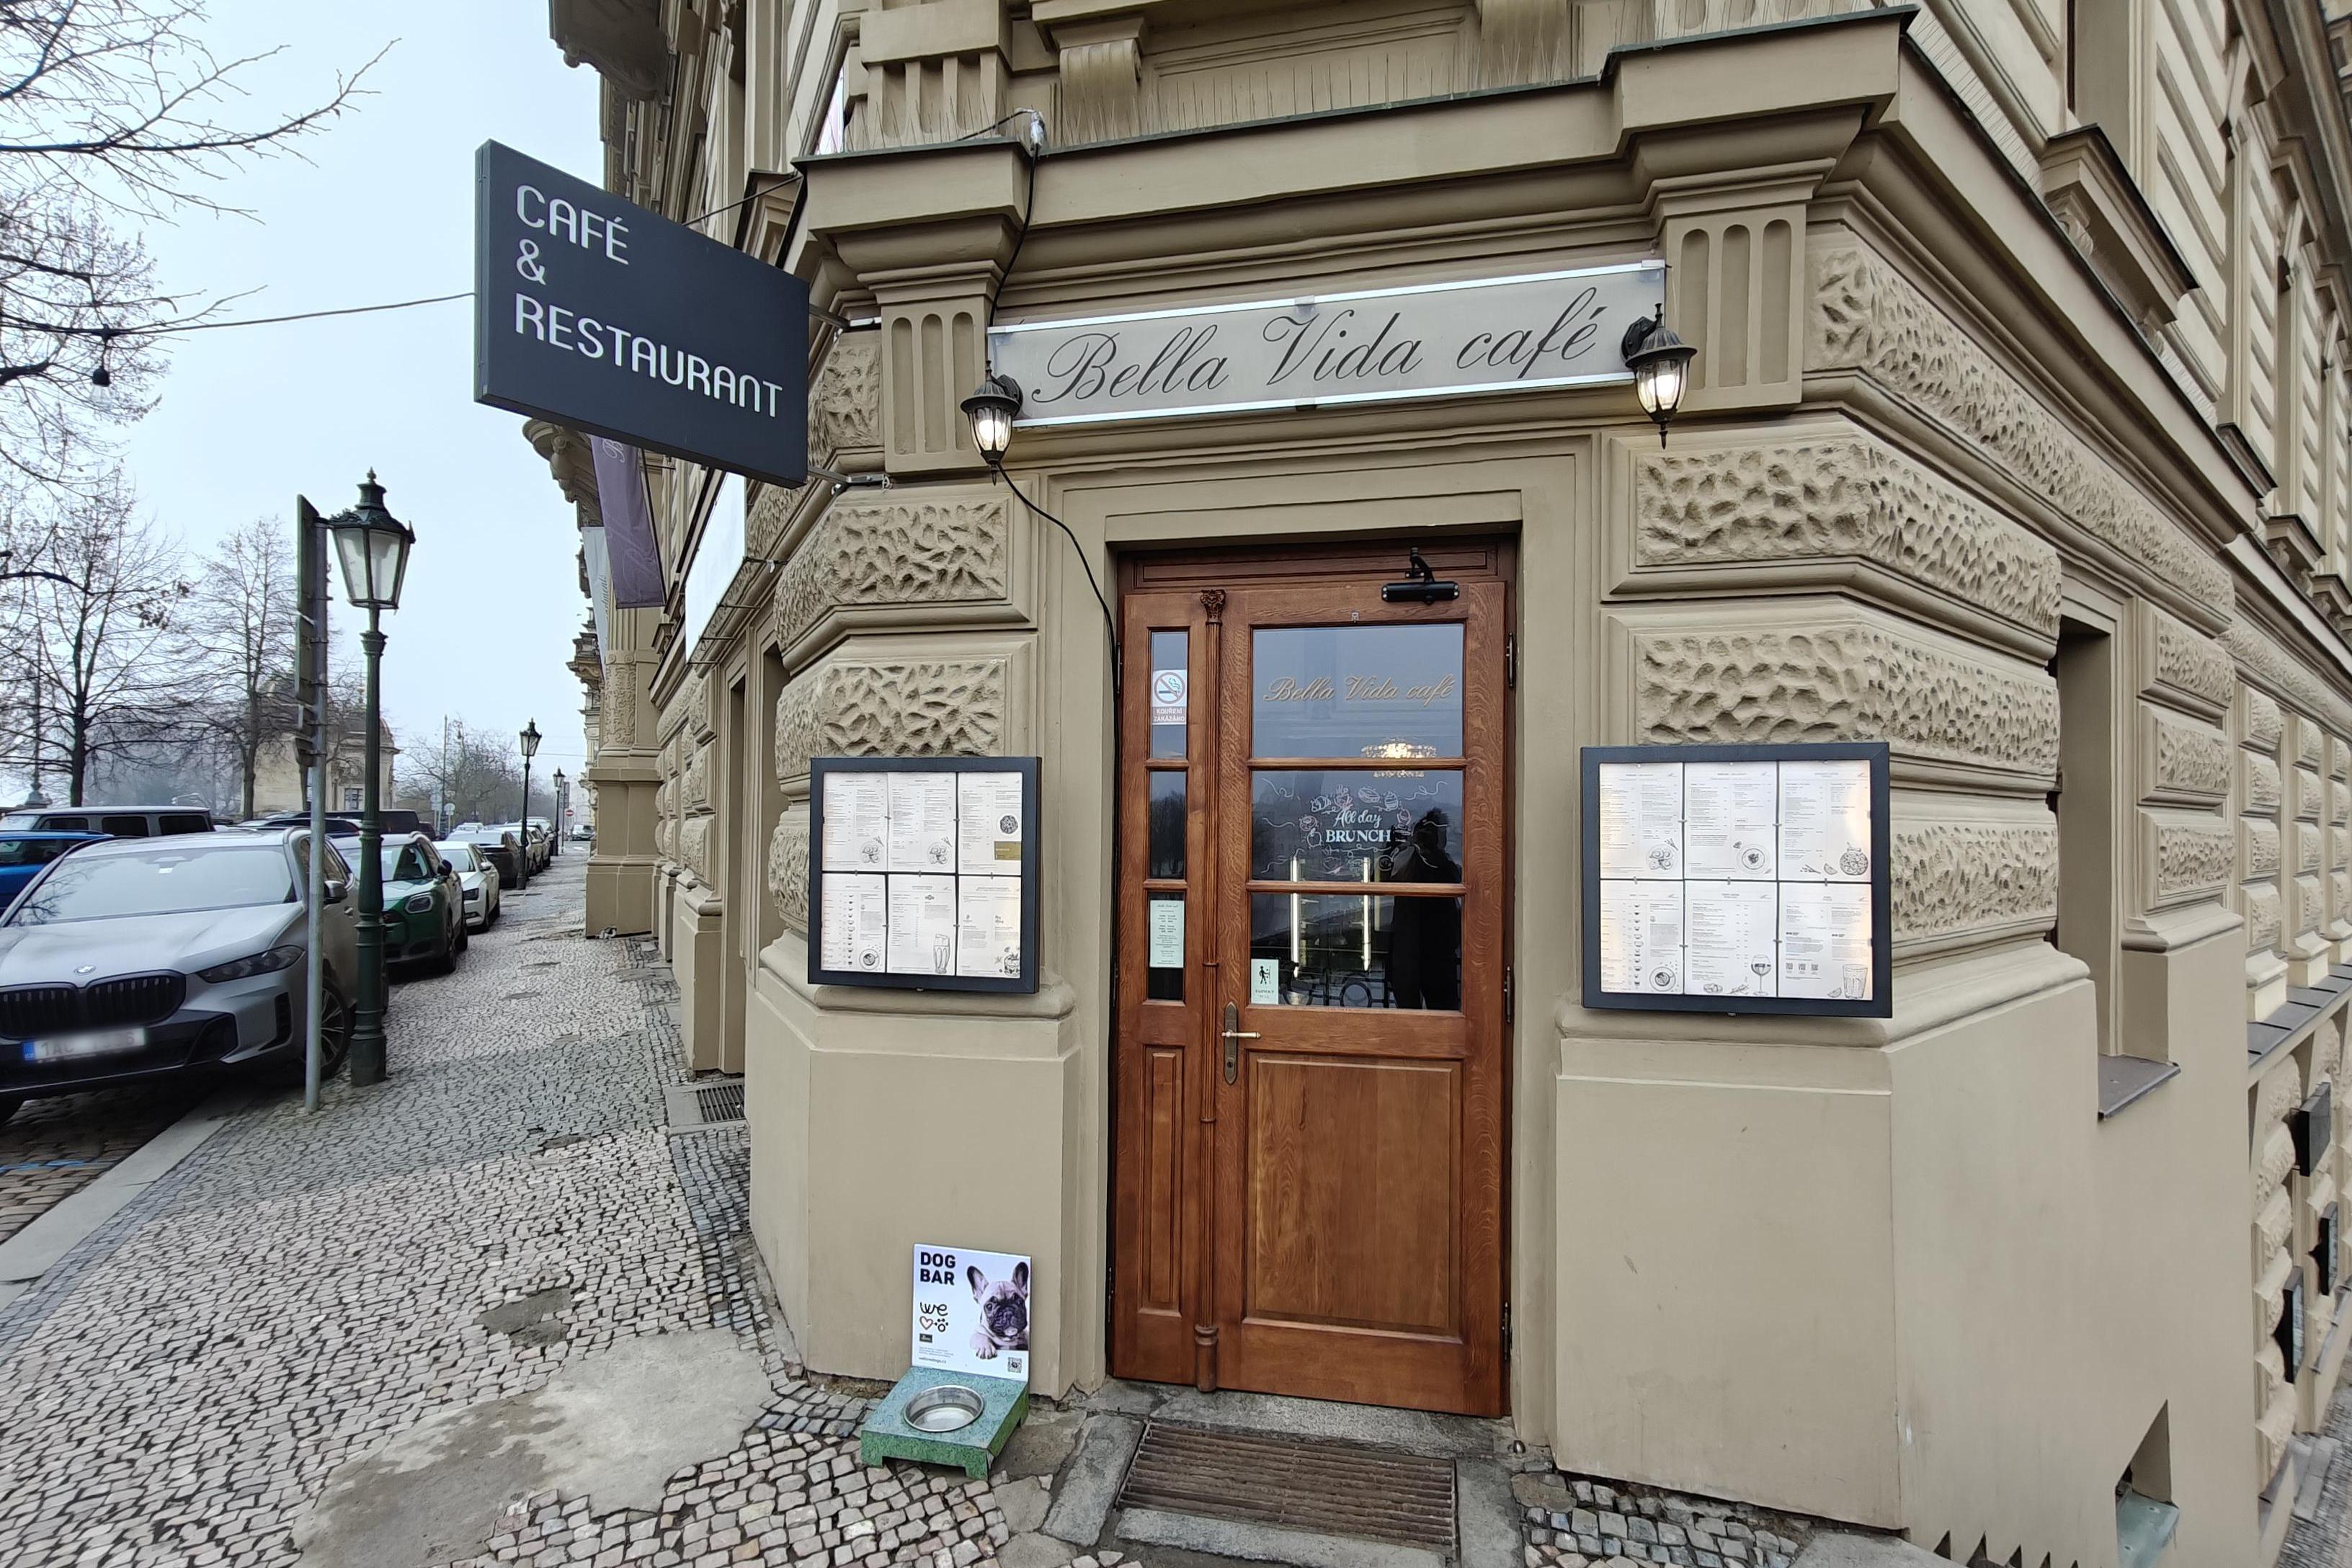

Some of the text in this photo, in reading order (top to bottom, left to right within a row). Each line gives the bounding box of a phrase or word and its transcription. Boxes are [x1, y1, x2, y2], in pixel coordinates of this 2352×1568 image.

[516, 185, 629, 265] CAFÉ
[516, 239, 547, 285] &
[515, 292, 783, 418] RESTAURANT
[1031, 286, 1608, 403] Bella Vida café
[1262, 673, 1454, 708] Bella Vida café
[1332, 808, 1382, 829] All day
[1325, 829, 1391, 842] BRUNCH
[920, 1251, 956, 1268] DOG
[919, 1268, 955, 1286] BAR
[919, 1301, 948, 1317] we
